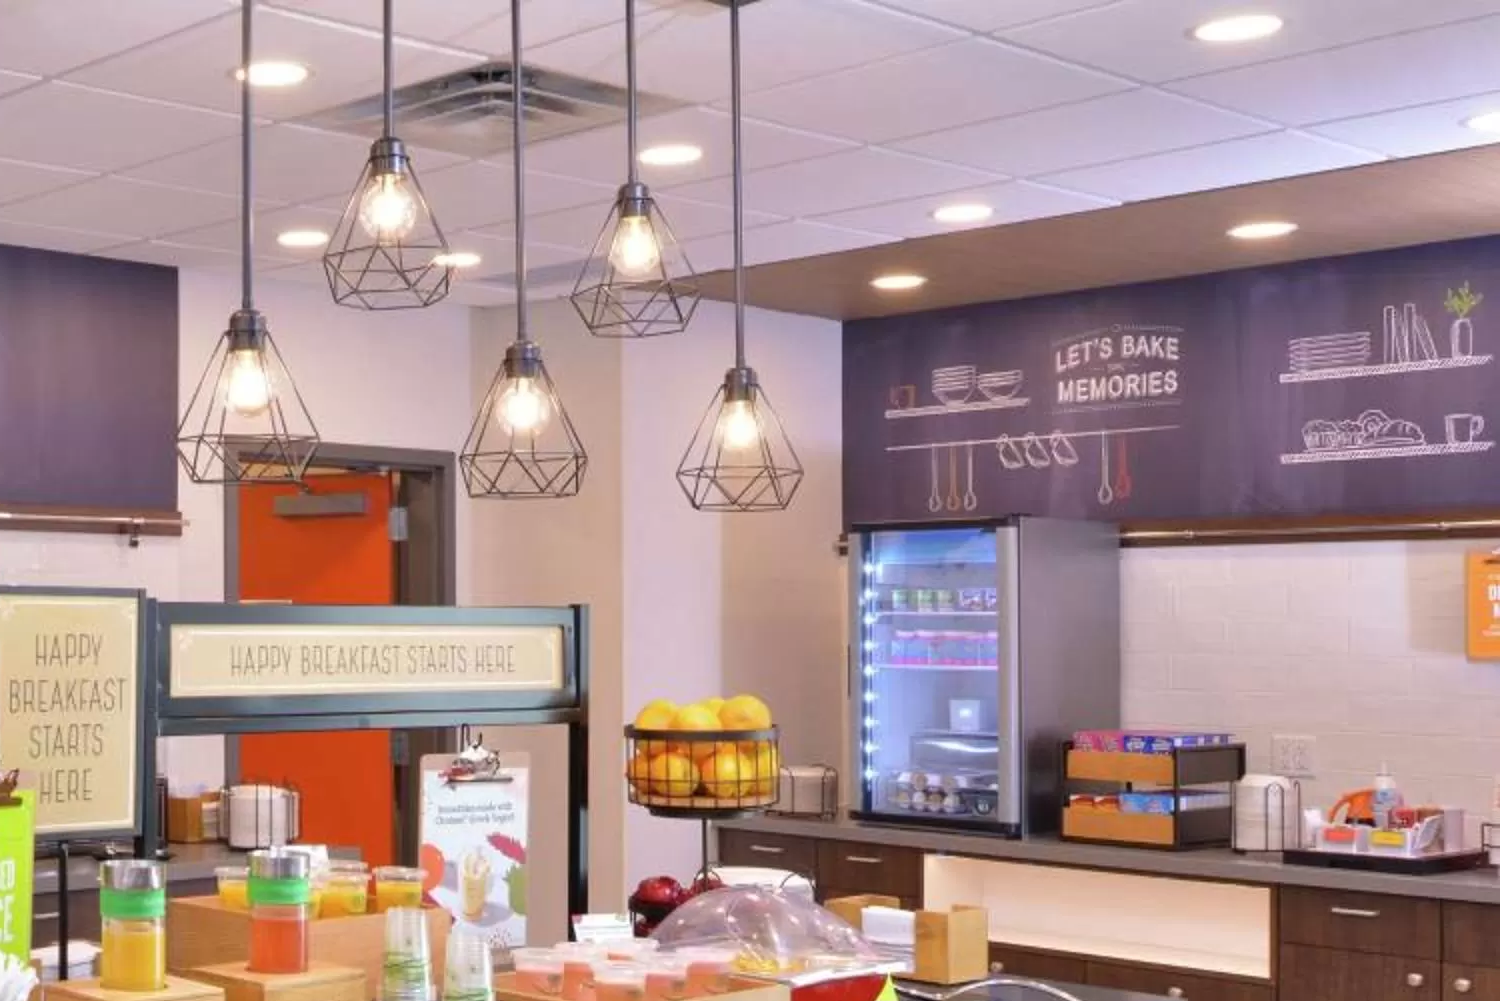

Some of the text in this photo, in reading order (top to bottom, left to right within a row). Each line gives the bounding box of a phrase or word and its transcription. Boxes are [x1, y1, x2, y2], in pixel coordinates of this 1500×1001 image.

[1056, 335, 1181, 373] LET'S BAKE
[1057, 370, 1179, 404] MEMORIES
[35, 633, 103, 668] HAPPY
[230, 644, 517, 676] HAPPY BREAKFAST STARTS HERE
[9, 677, 128, 714] BREAKFAST
[29, 723, 104, 760] STARTS
[39, 768, 93, 805] HERE
